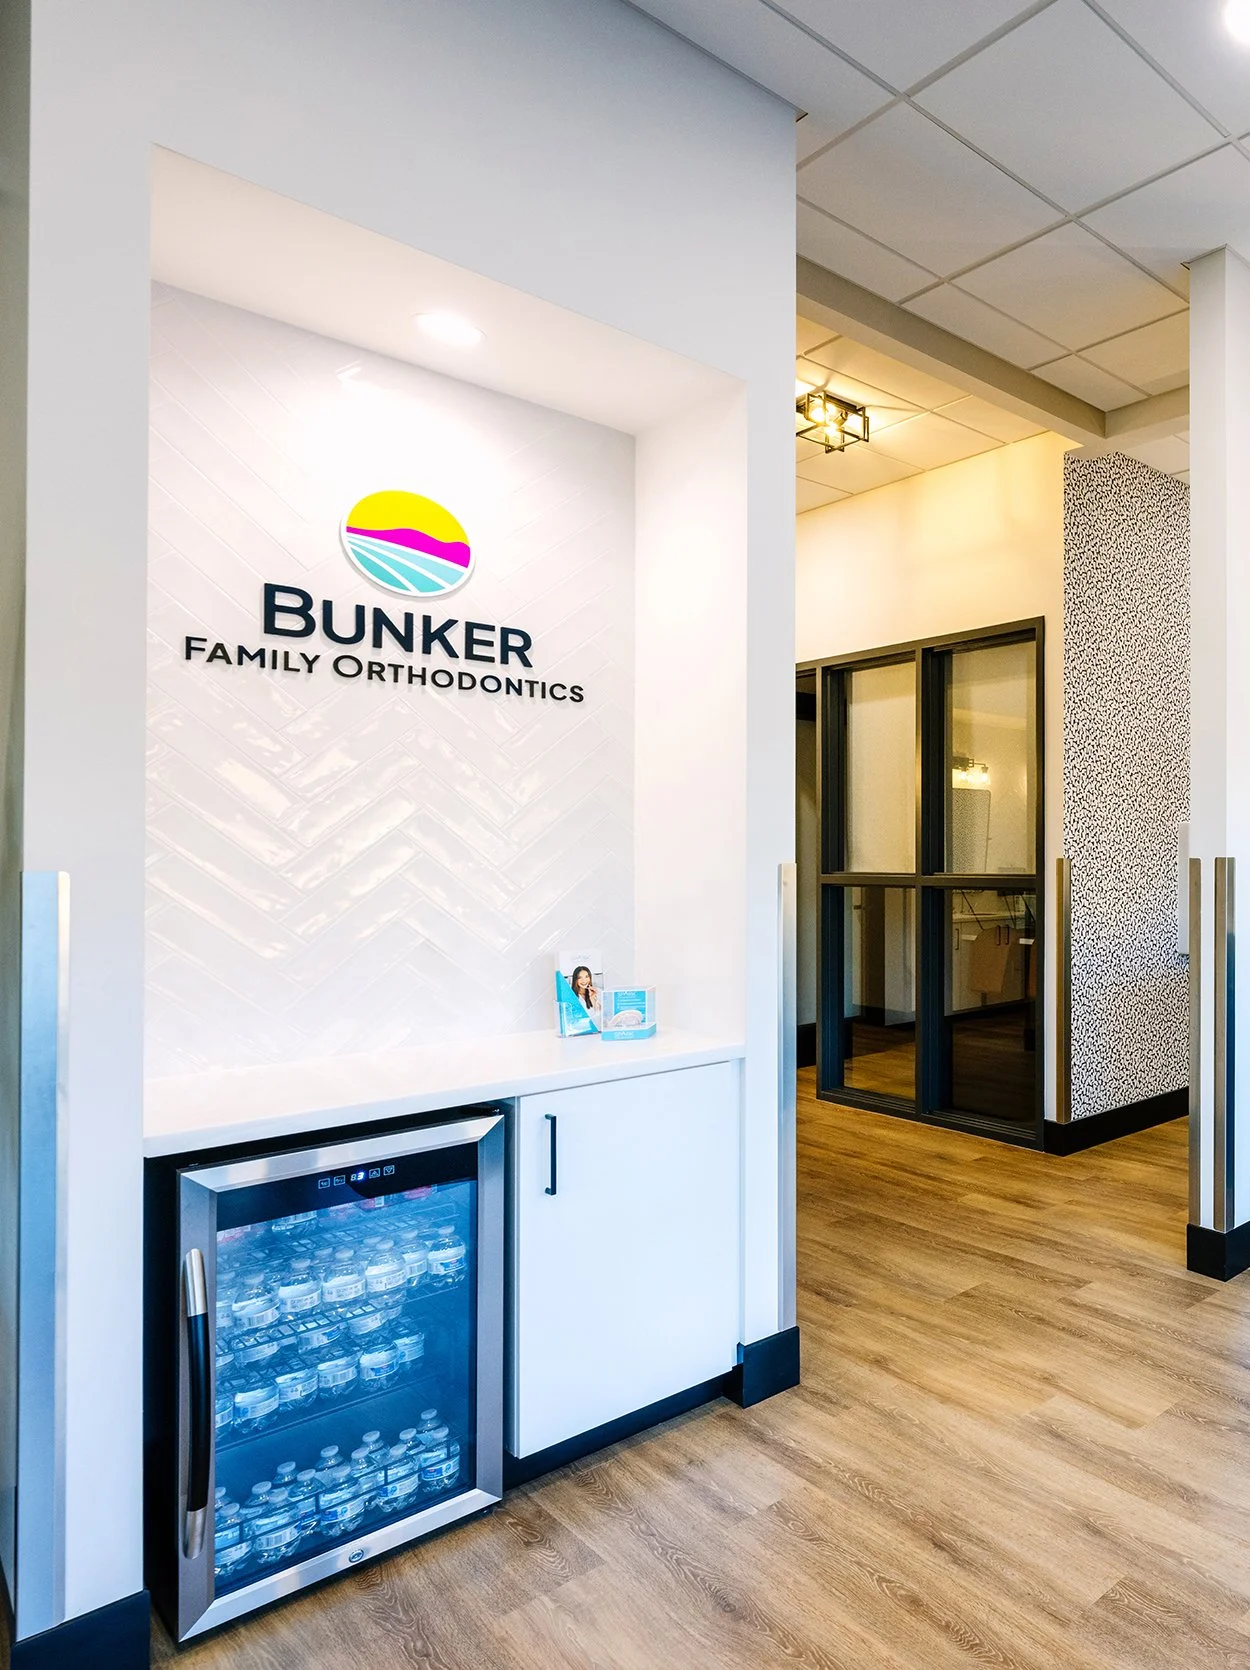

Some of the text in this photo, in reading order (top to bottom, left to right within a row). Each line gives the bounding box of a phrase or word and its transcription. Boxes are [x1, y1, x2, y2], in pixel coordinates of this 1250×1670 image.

[263, 583, 532, 668] BUNKER
[184, 636, 585, 702] FAMILY ORTHODONTICS
